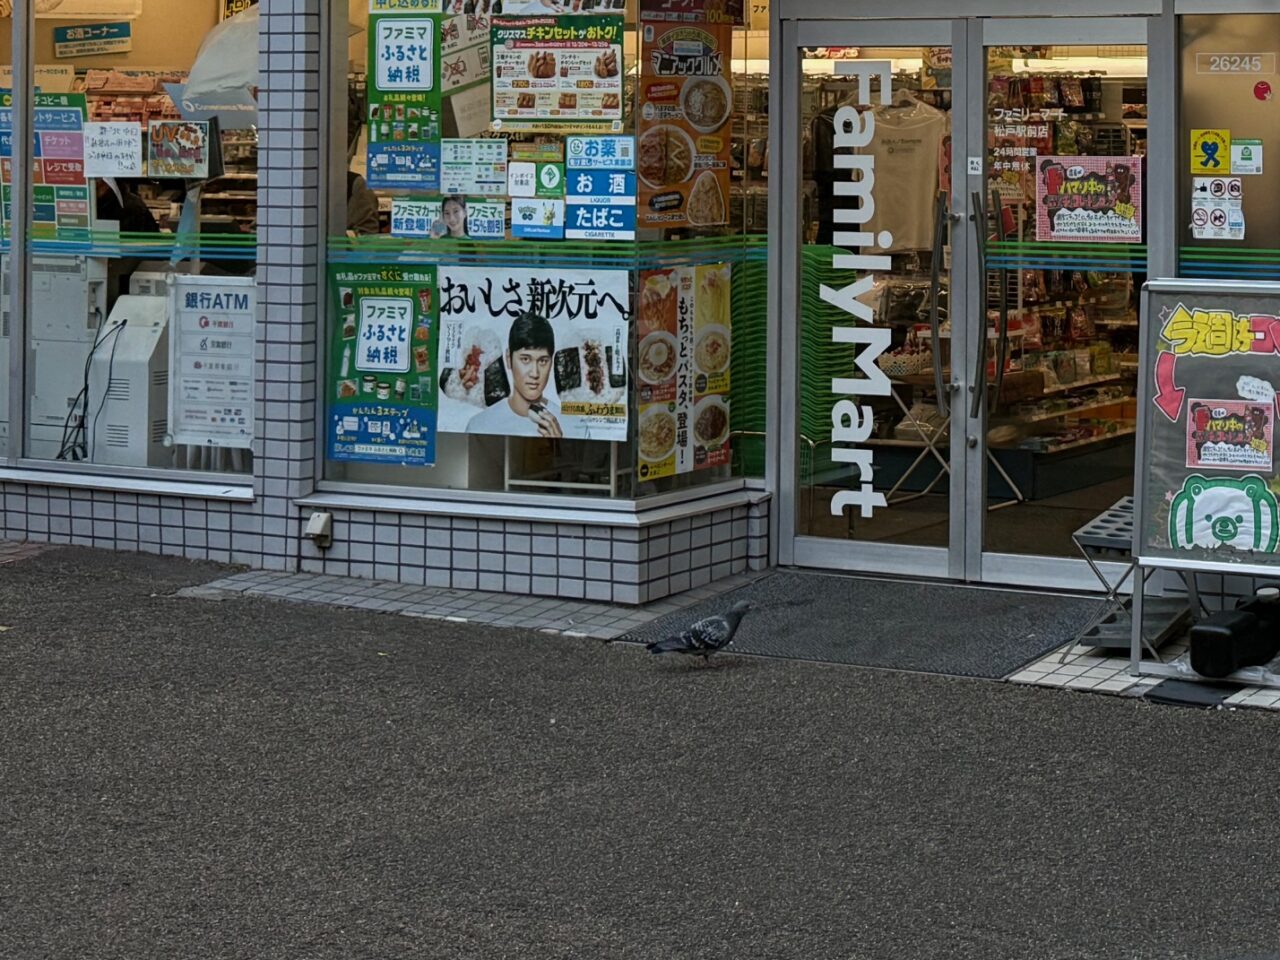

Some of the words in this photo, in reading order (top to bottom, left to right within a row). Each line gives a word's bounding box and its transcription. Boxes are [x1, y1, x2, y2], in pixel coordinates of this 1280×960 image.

[383, 26, 427, 40] ファミマ
[381, 44, 427, 61] ふるさと
[1209, 55, 1262, 72] 26245
[387, 65, 421, 83] 納税
[993, 107, 1068, 121] ファミリーマート
[993, 124, 1049, 138] 松戸駅前店
[44, 135, 71, 145] チケット
[584, 139, 616, 158] お薬
[993, 147, 1038, 157] 24時間営業
[993, 162, 1031, 171] 年中無休
[576, 173, 626, 194] お酒
[393, 205, 441, 217] ファミマカード
[576, 207, 624, 228] たばこ
[393, 219, 432, 232] 新登場!!
[819, 60, 893, 519] FamilyMart
[185, 291, 249, 310] 銀行ATM
[440, 276, 630, 321] おいしさ新次元へ。
[366, 305, 408, 320] ファミマ
[362, 324, 406, 342] ふるさと
[366, 345, 398, 364] 納税
